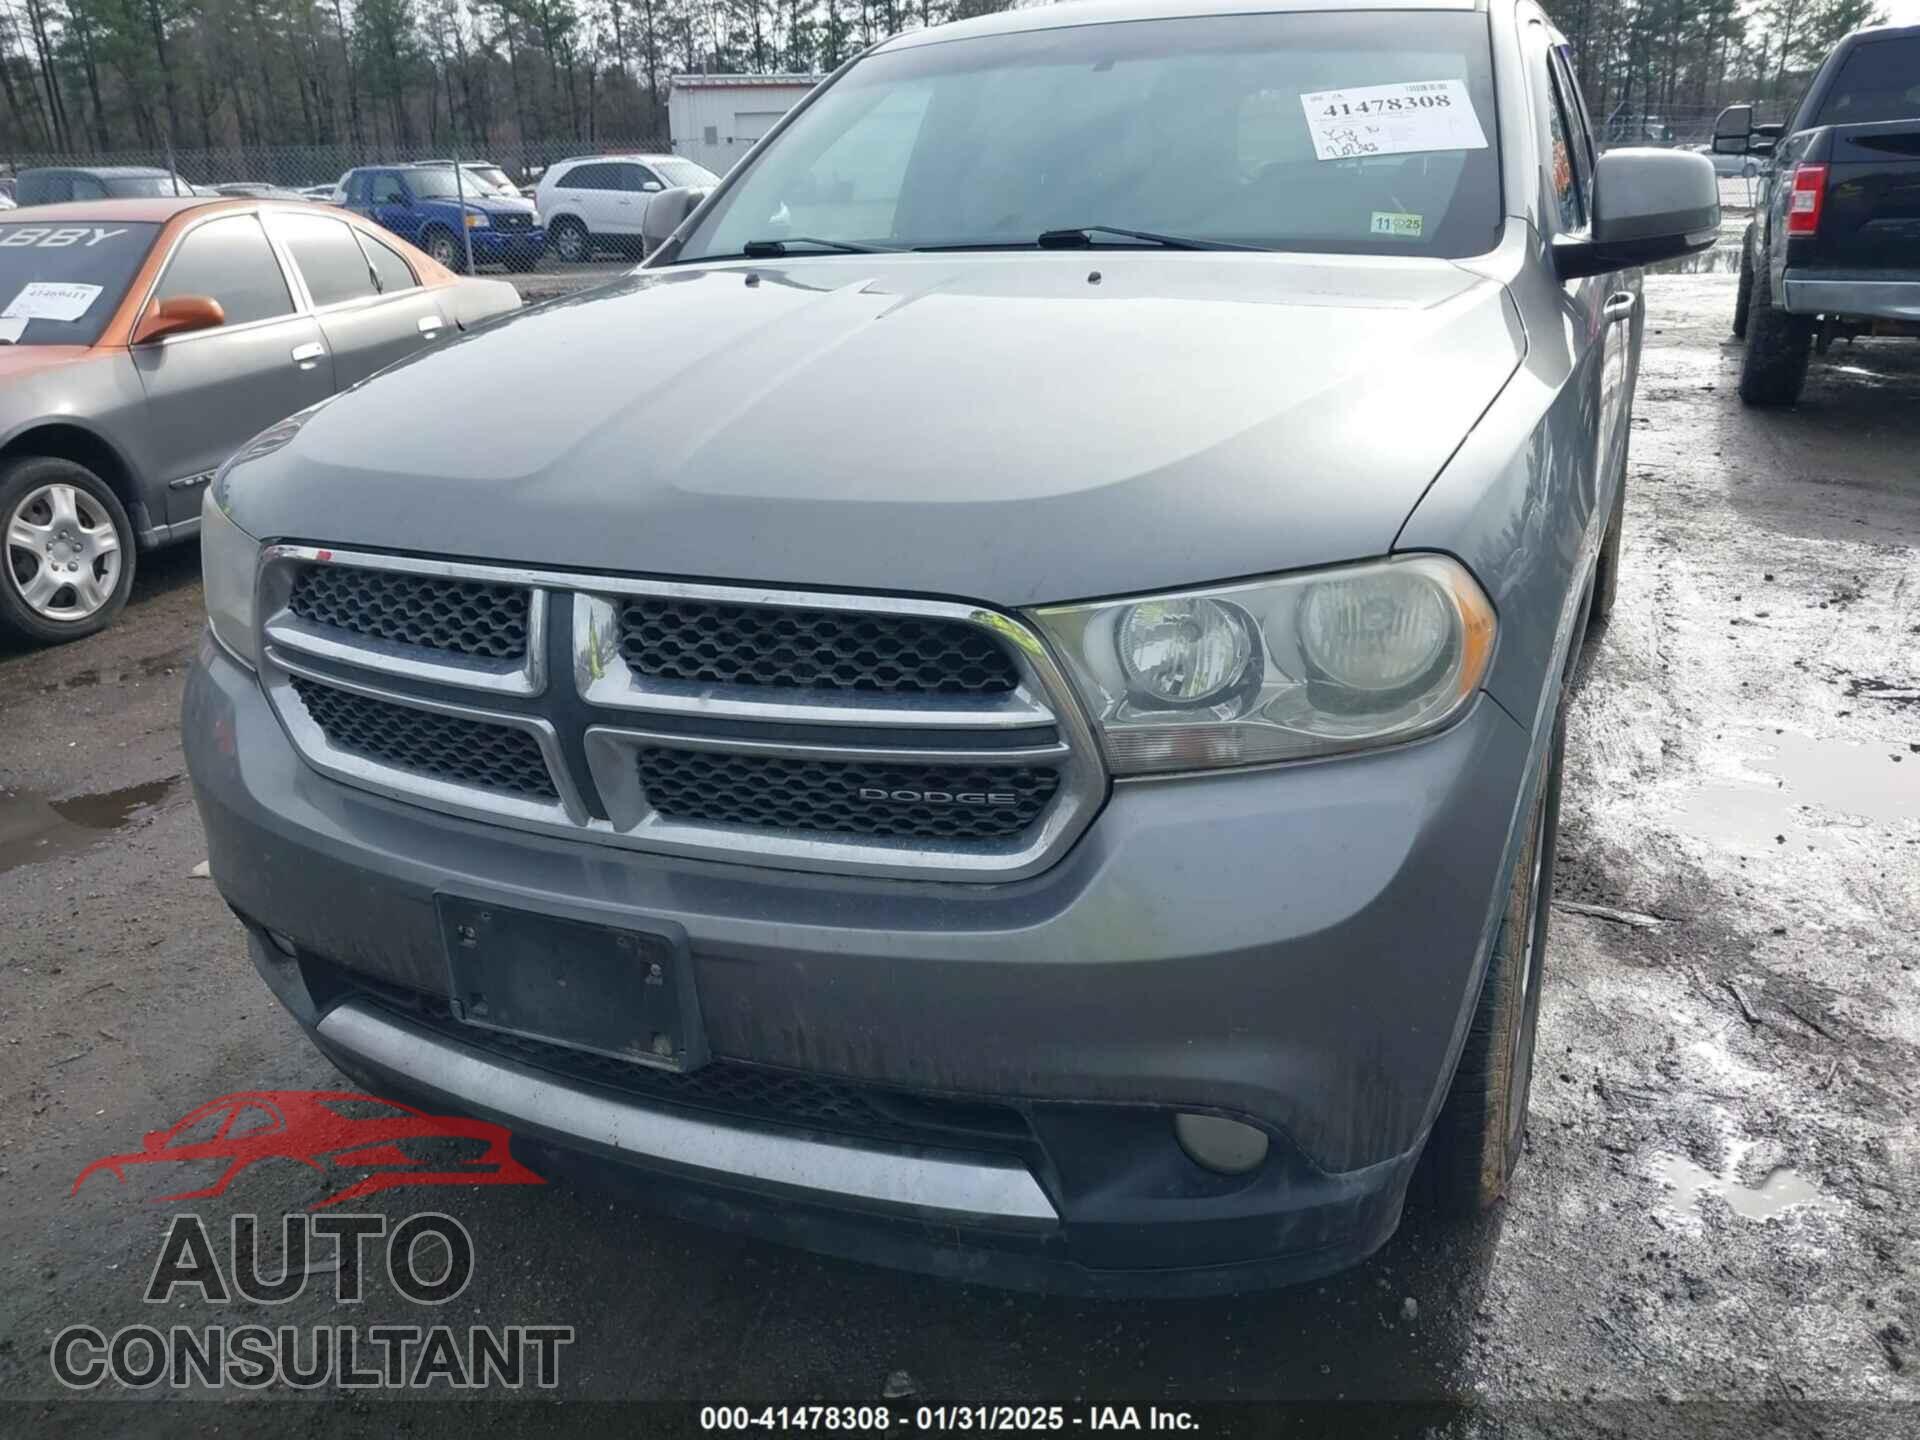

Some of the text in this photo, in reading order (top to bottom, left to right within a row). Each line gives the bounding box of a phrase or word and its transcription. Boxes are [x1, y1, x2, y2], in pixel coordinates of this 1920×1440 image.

[1323, 95, 1451, 116] 41478308
[1375, 217, 1420, 230] 11 25
[0, 228, 129, 246] BBY
[859, 788, 1017, 804] DODGE
